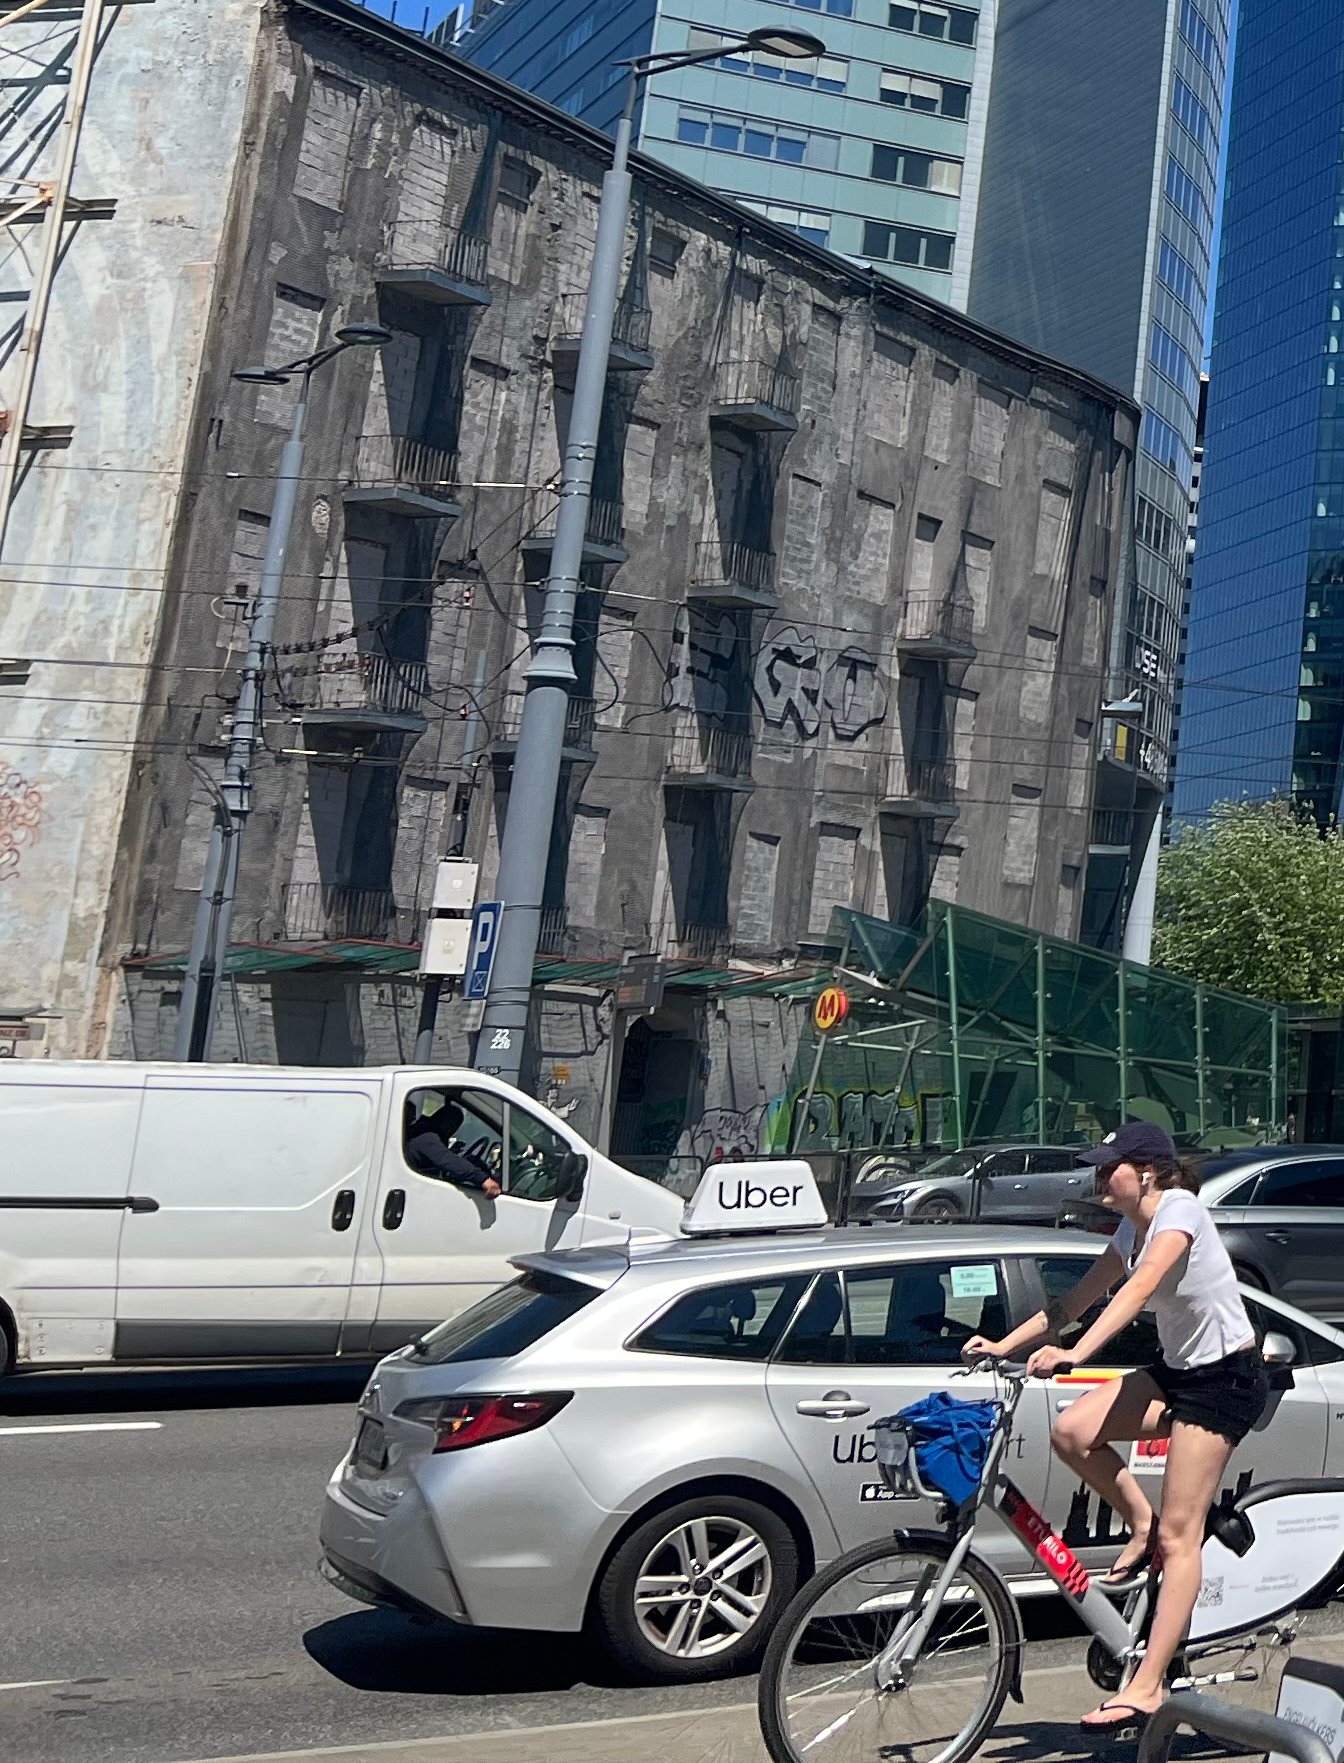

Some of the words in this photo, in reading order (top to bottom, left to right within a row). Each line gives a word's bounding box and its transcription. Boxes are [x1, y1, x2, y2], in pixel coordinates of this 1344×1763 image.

[473, 911, 495, 970] P
[718, 1180, 804, 1210] Uber
[832, 1433, 878, 1464] Ub
[1024, 1512, 1068, 1565] ETURILO
